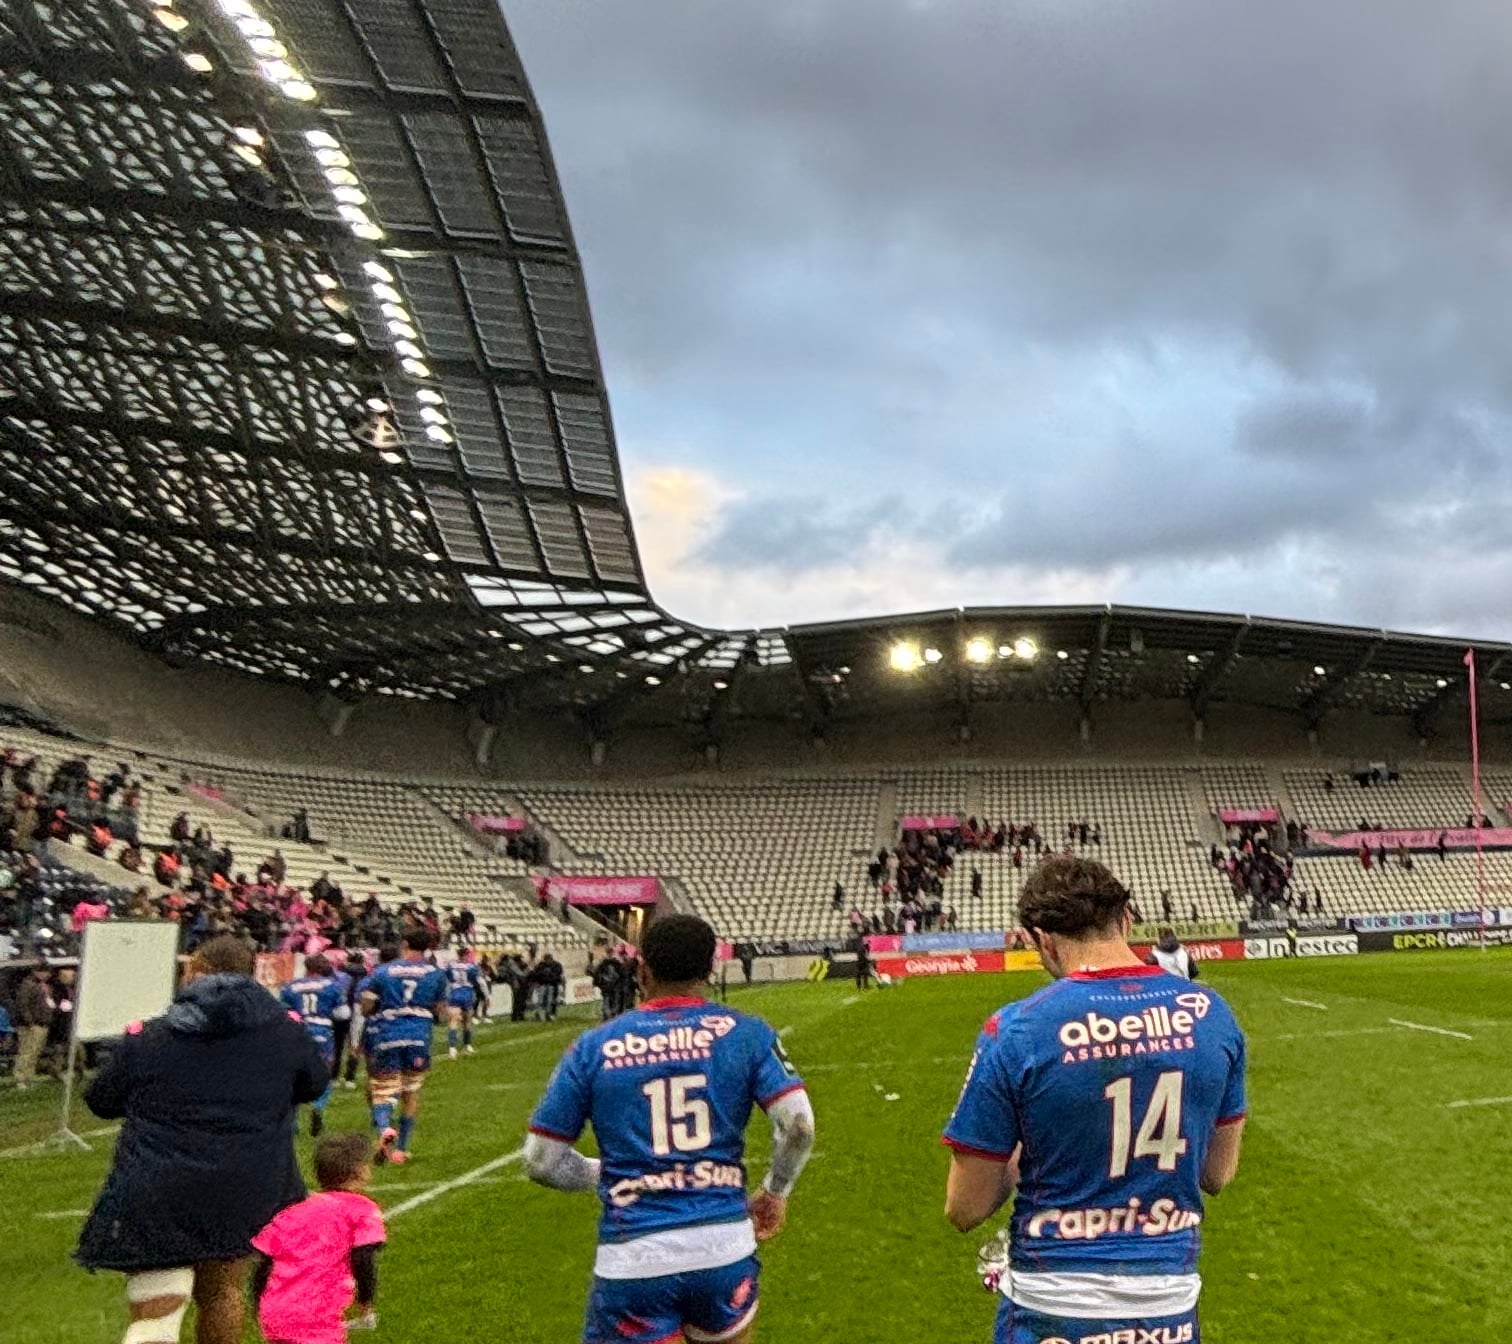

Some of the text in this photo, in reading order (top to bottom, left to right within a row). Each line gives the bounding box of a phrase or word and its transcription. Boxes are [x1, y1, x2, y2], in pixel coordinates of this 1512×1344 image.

[1266, 936, 1359, 959] Inestec
[602, 1026, 714, 1059] abeille
[1059, 1005, 1194, 1048] abeille
[1061, 1035, 1196, 1065] ASSURANCES
[643, 1074, 713, 1156] 15
[1104, 1070, 1188, 1180] 14
